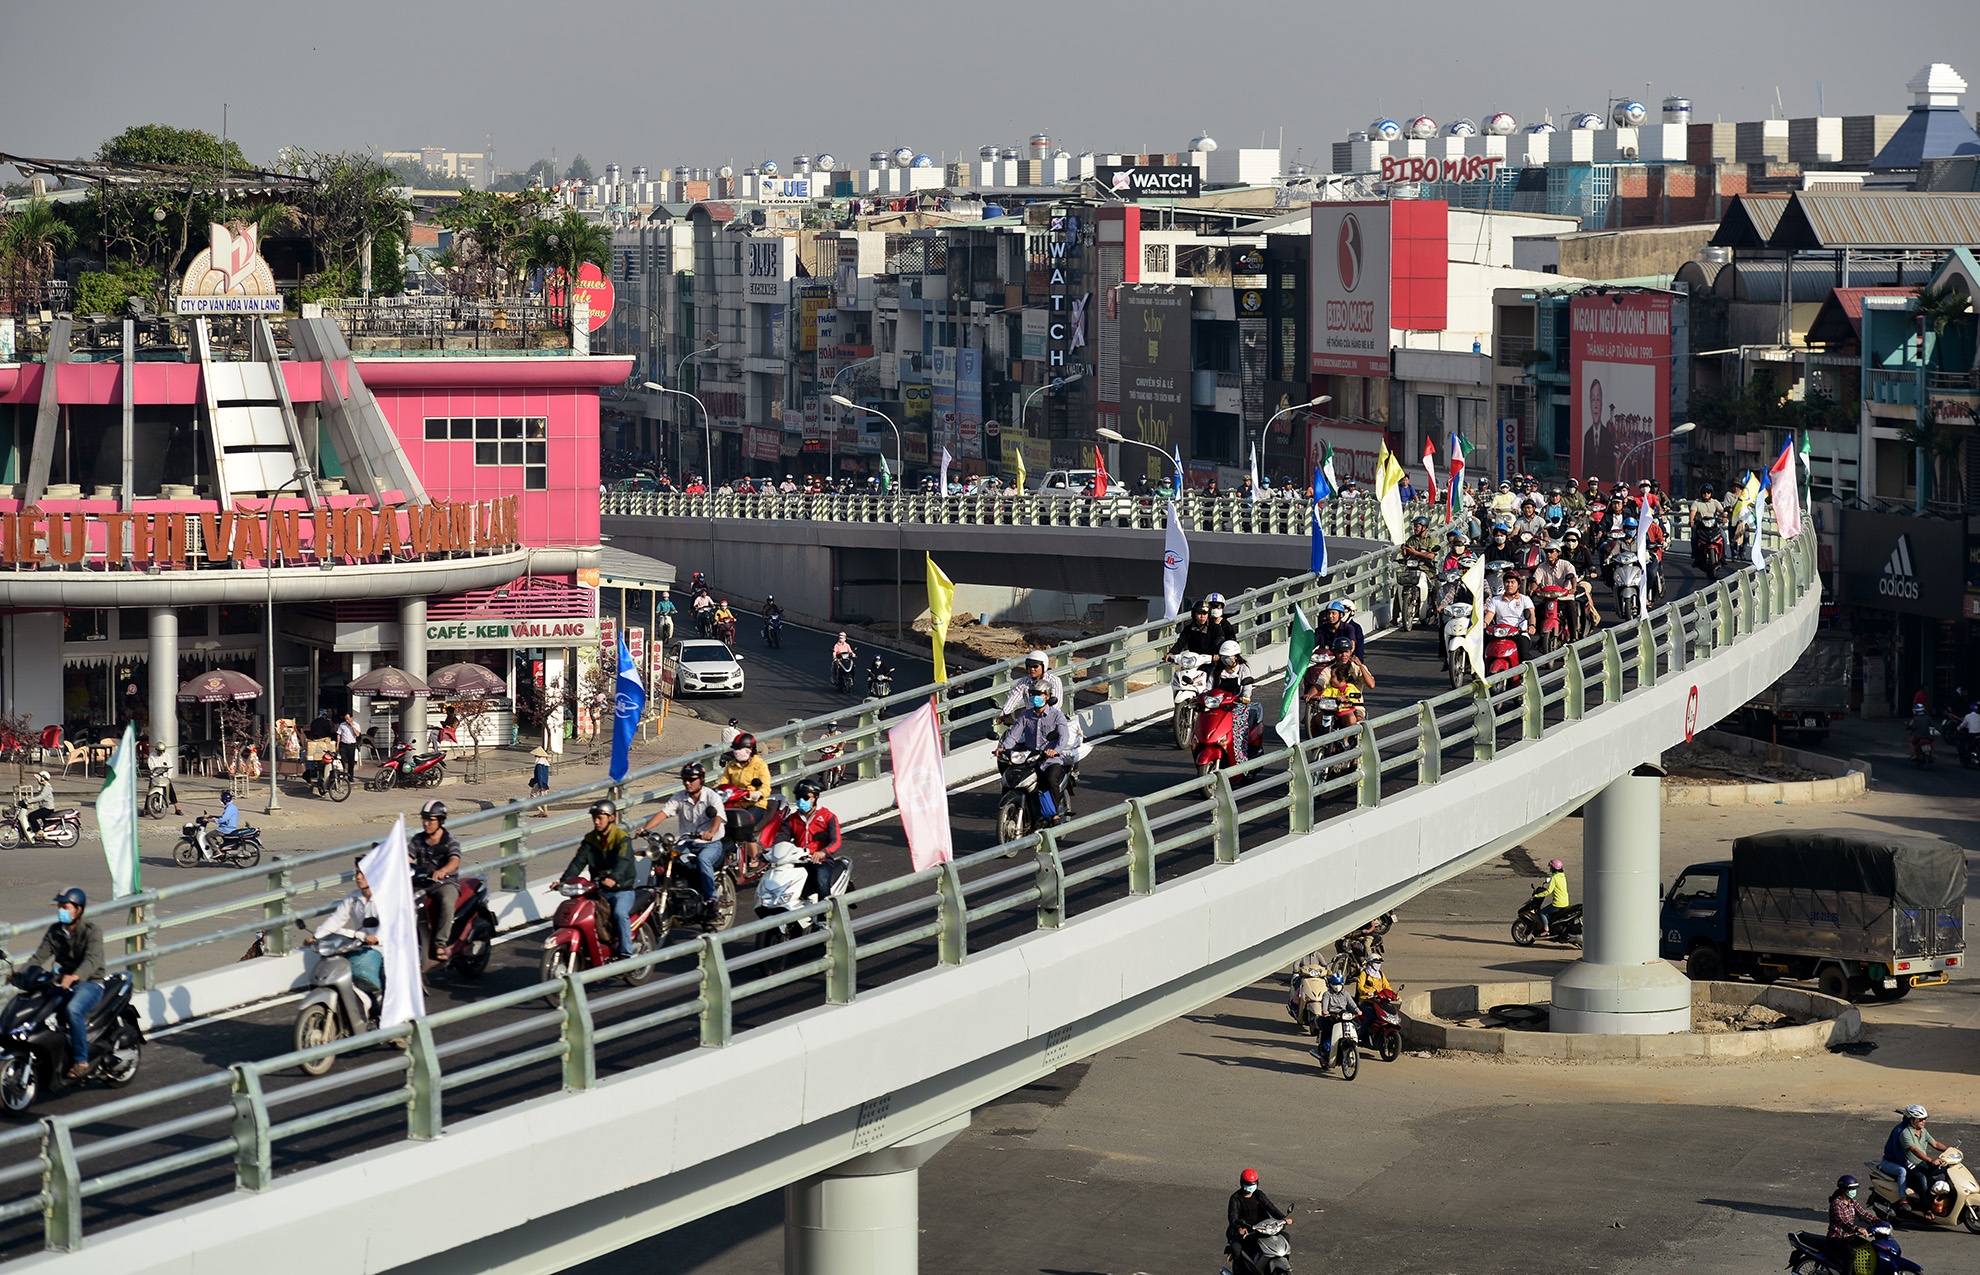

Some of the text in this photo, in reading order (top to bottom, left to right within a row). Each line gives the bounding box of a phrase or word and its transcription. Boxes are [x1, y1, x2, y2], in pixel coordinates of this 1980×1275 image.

[1132, 173, 1192, 188] WATCH
[1381, 155, 1503, 183] BIBO MART
[748, 243, 777, 277] BLUE
[749, 283, 777, 296] EXCHANGE
[181, 297, 280, 311] CTY CP VĂN HÓA VĂN LANG
[1327, 300, 1374, 333] BIBO MART
[1573, 308, 1598, 339] NGOẠI
[1646, 310, 1669, 335] MINH
[1506, 424, 1515, 443] GO
[1506, 444, 1515, 454] &
[1506, 456, 1515, 480] HOP
[0, 504, 86, 564] IÊU
[200, 501, 299, 561] VĂN
[407, 495, 470, 553] VĂN
[1879, 576, 1919, 600] adidas
[476, 624, 509, 638] KEM
[510, 620, 541, 637] VĂN
[542, 623, 585, 637] LANG
